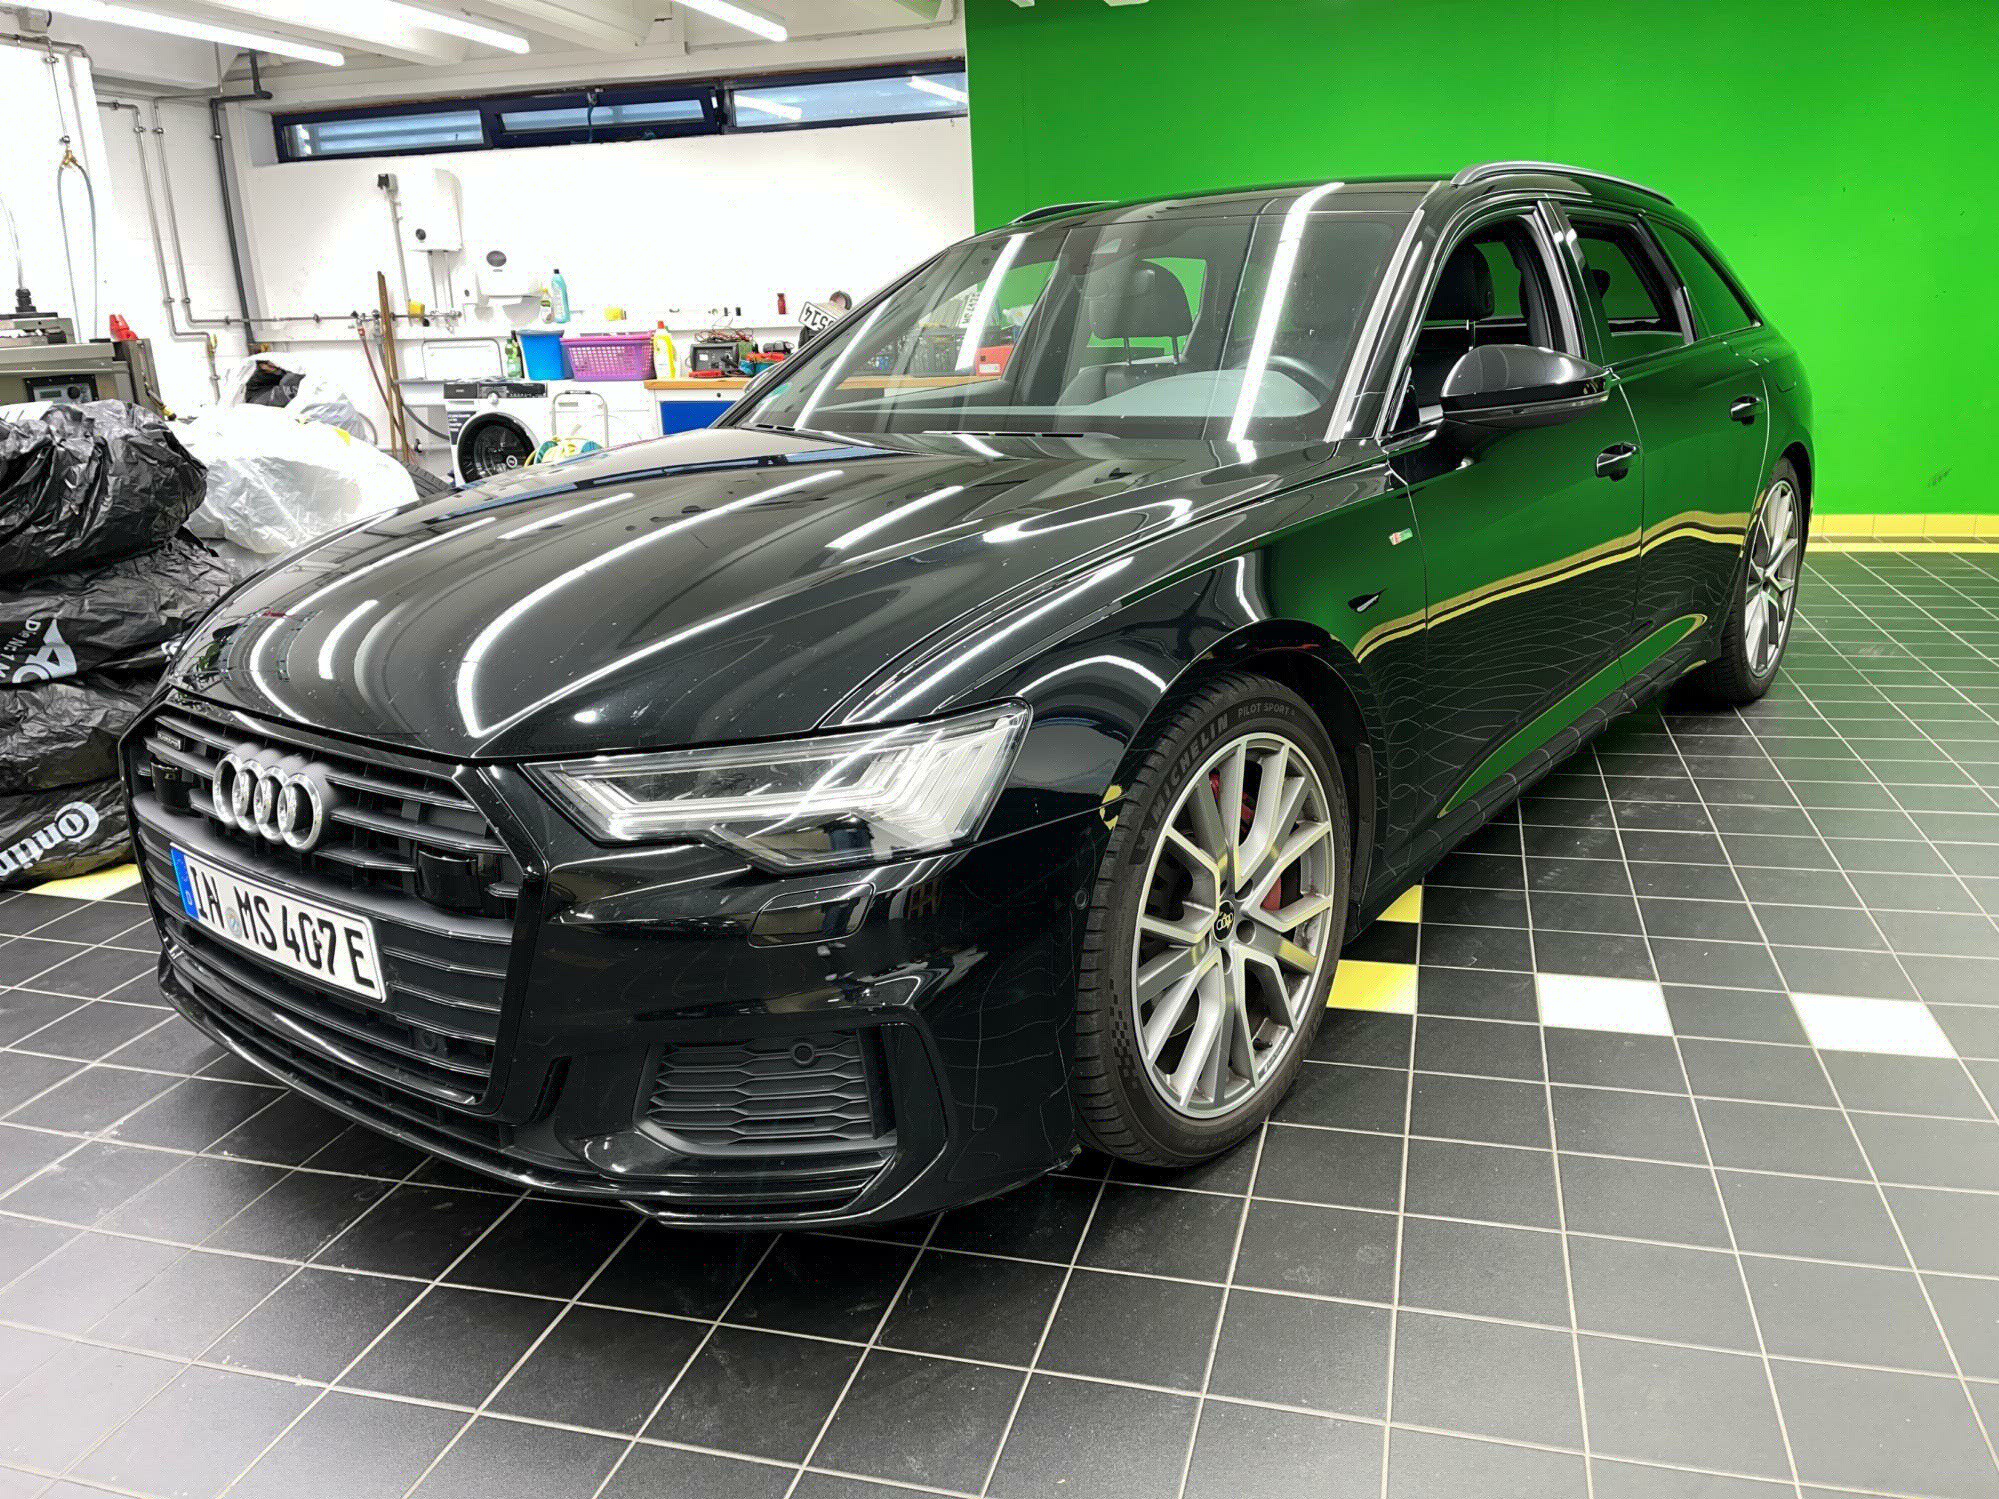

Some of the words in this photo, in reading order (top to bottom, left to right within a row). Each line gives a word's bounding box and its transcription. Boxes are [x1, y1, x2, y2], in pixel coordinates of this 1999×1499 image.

[1238, 703, 1262, 719] PILOT
[1263, 702, 1290, 716] SPORT
[1151, 712, 1229, 822] MICHELIN
[190, 866, 225, 929] IN
